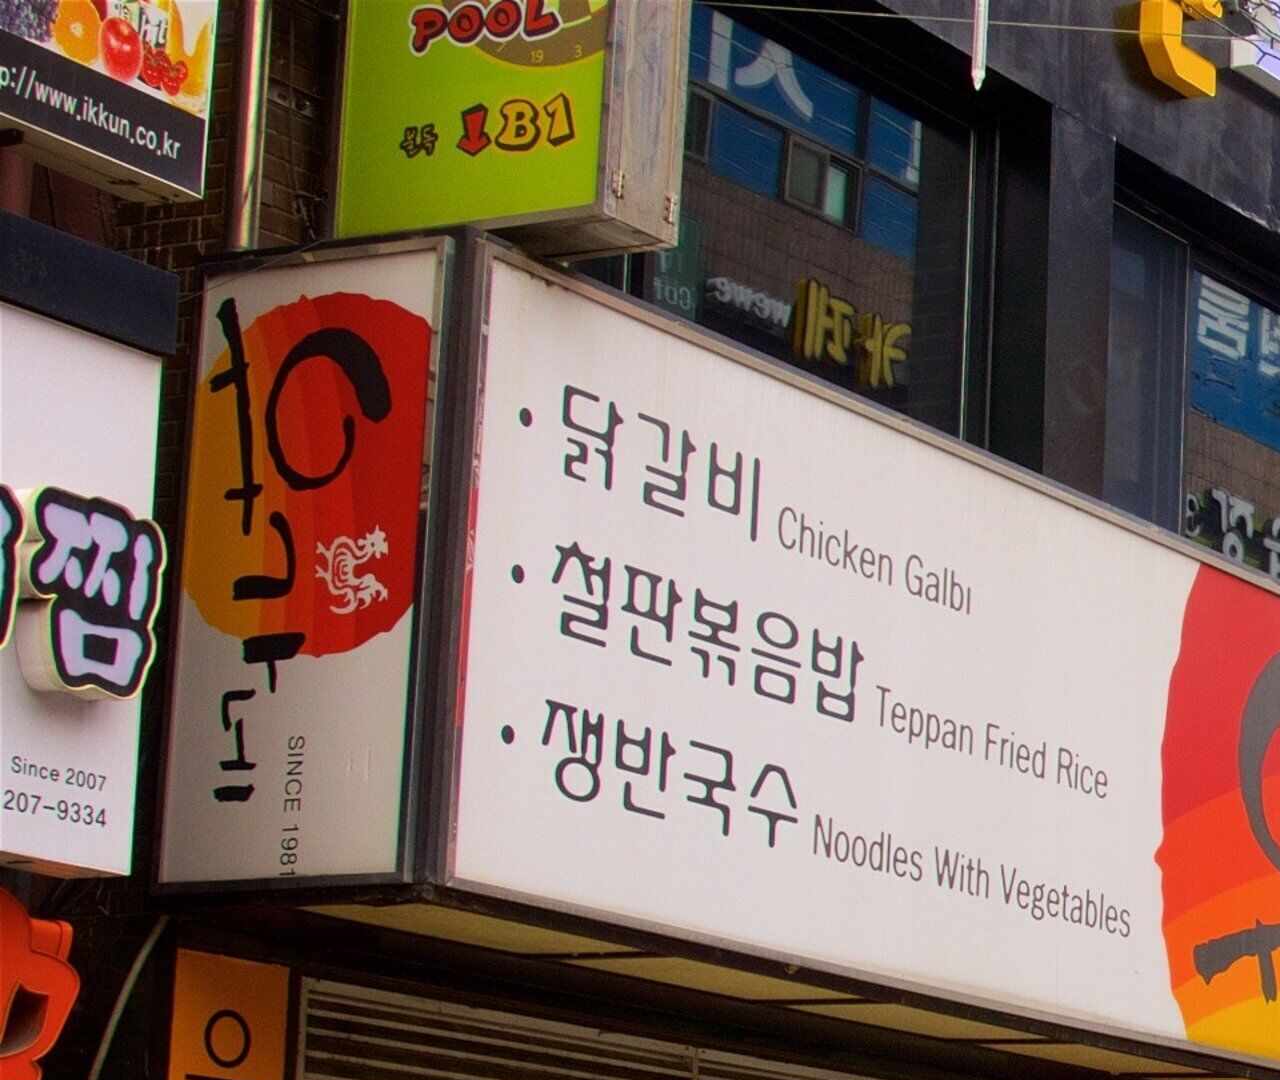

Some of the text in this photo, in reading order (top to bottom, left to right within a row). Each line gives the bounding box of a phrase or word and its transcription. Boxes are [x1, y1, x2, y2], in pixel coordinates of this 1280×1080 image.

[409, 0, 565, 54] POOL
[495, 92, 577, 152] B1
[561, 384, 973, 615] 닭갈비 Chicken Galbi
[551, 540, 1110, 801] 철판볶음밥 Teppan Fried Rice
[11, 755, 108, 792] Since 2007
[279, 734, 306, 879] SINCE 1981
[541, 698, 1133, 939] 쟁반국수 Noodles With Vegetables
